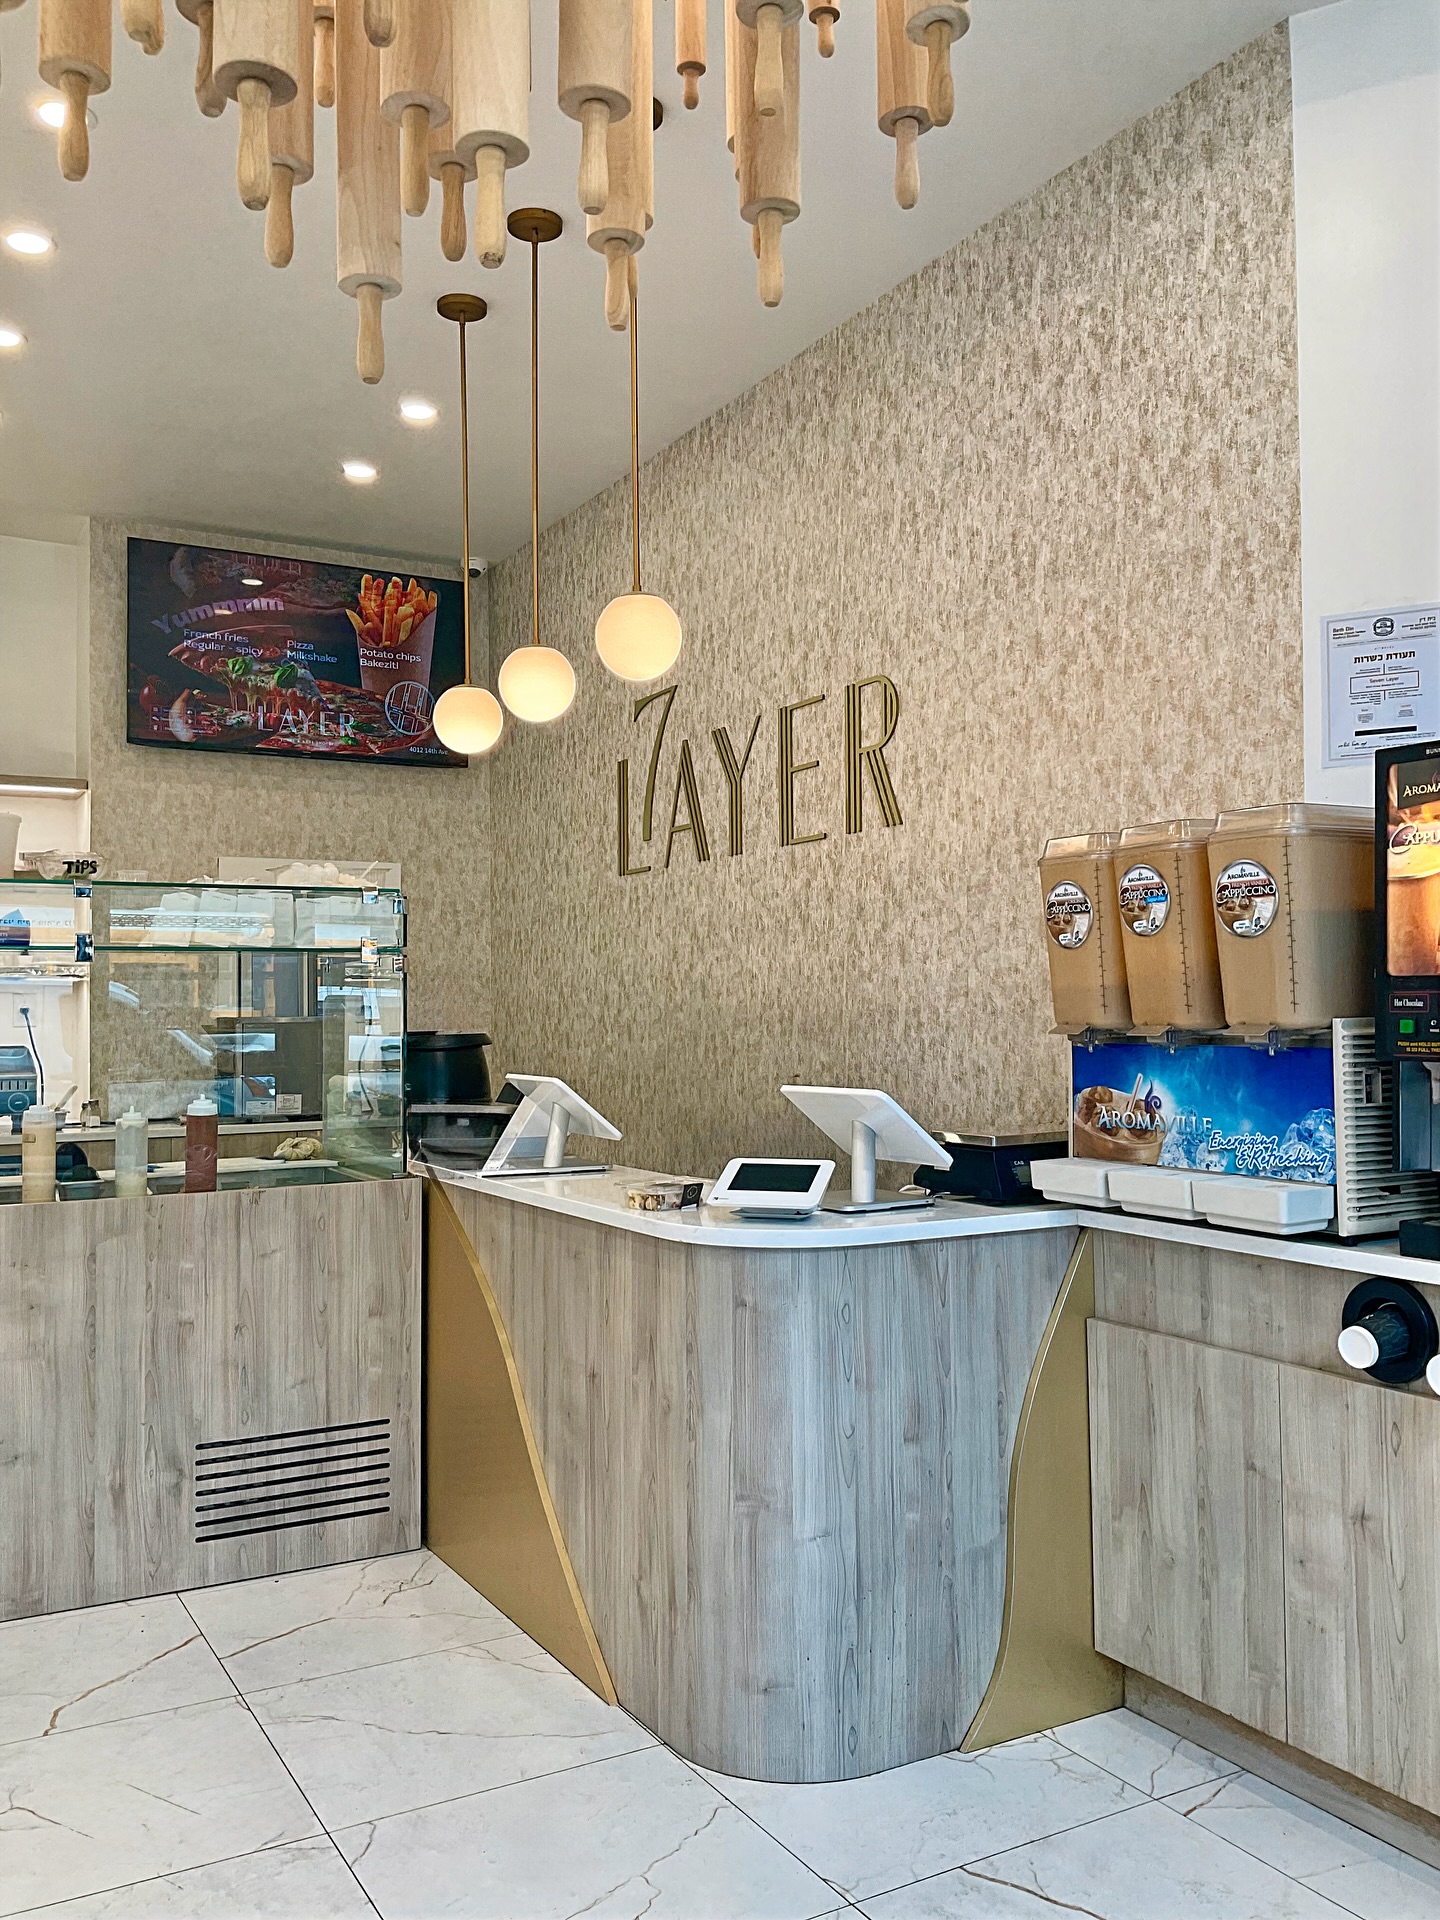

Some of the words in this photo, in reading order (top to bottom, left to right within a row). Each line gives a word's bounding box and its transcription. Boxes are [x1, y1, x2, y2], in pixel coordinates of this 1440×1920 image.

[183, 628, 222, 641] French
[224, 631, 249, 643] fries
[183, 639, 226, 652] Regular
[235, 644, 264, 658] spicy
[286, 639, 314, 651] Pizza
[286, 649, 338, 664] Milkshake
[359, 647, 394, 660] Potato
[395, 652, 422, 663] chips
[1353, 654, 1383, 664] כשרות
[1386, 650, 1416, 661] תעודת
[359, 657, 399, 670] Bakeziti
[257, 705, 355, 738] LAYER
[409, 746, 424, 754] 4012
[424, 747, 438, 755] 14th
[1227, 870, 1260, 880] AROMAVILLE
[1119, 885, 1168, 905] CAPPUCCINO
[1215, 882, 1276, 904] CAPPUCCINO
[1393, 998, 1403, 1007] Hot
[1403, 998, 1424, 1007] Chocolate
[1096, 1105, 1213, 1136] AROMAVILLE
[1208, 1130, 1279, 1156] Energizing
[1248, 1147, 1330, 1174] Refreshing
